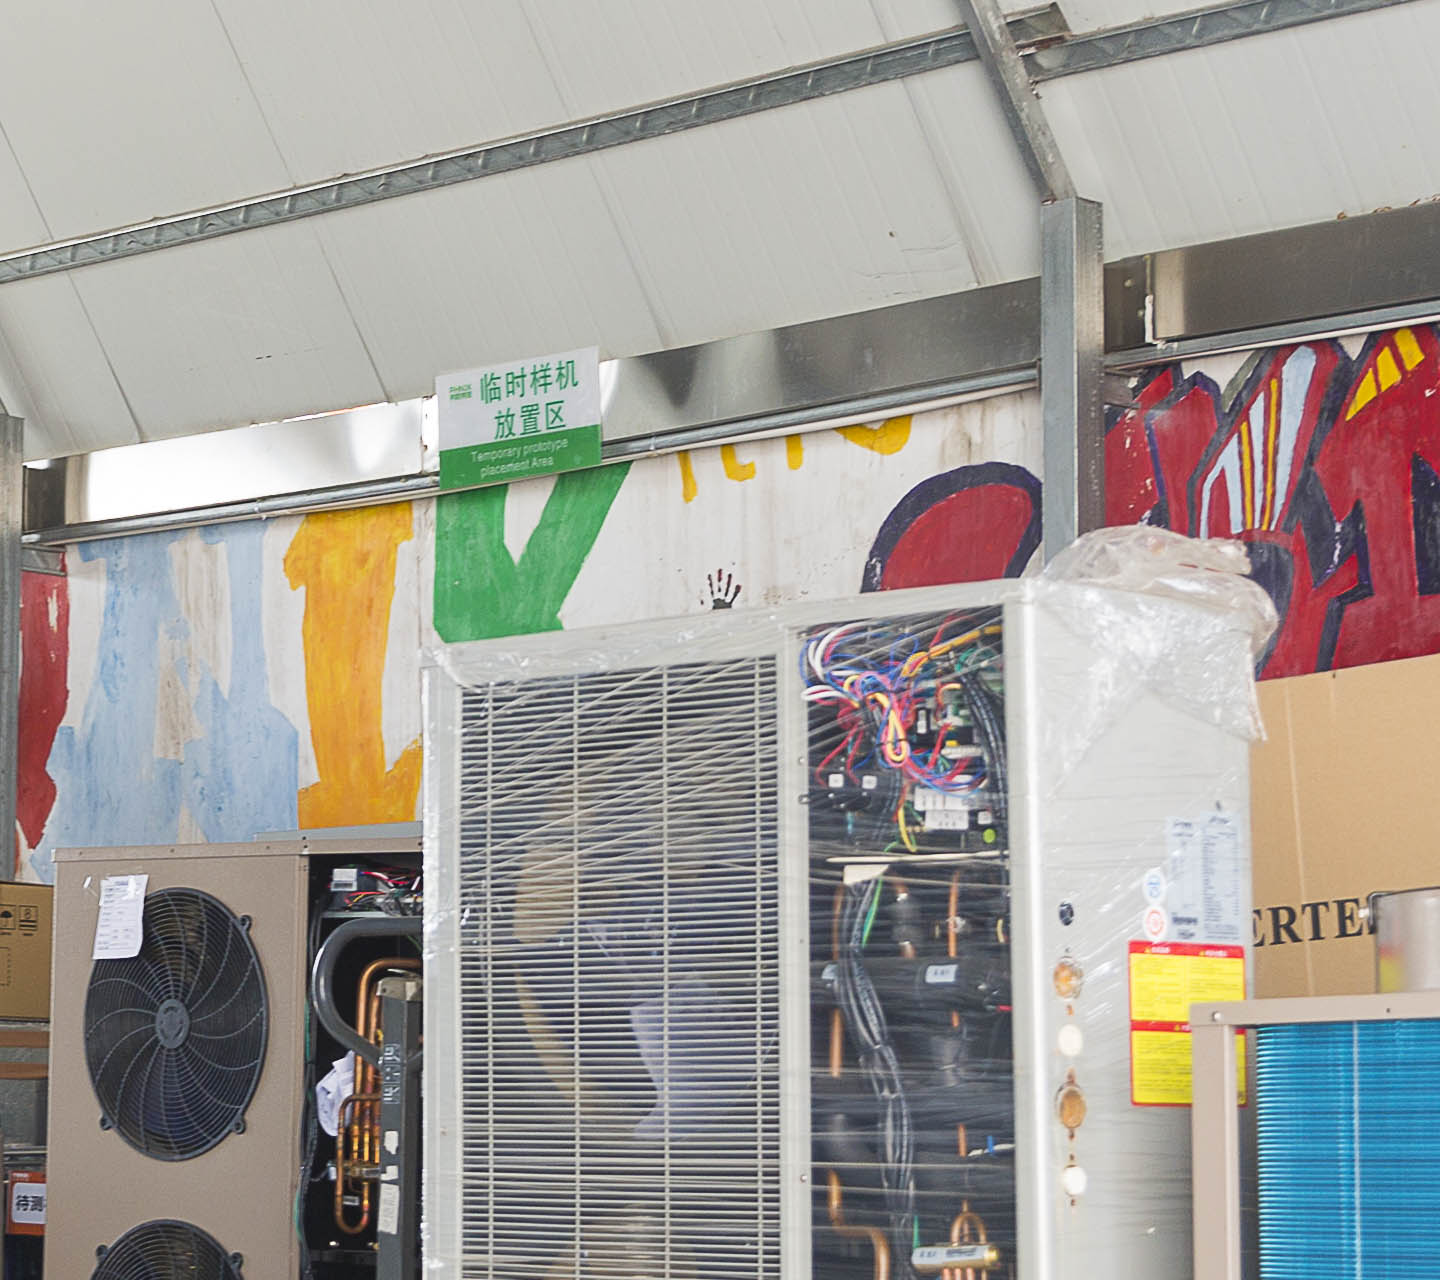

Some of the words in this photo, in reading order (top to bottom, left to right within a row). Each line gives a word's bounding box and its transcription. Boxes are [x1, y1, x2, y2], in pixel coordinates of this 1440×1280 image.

[480, 360, 579, 404] 临时样机
[494, 400, 567, 440] 放置区
[471, 446, 522, 464] Temporary
[523, 437, 569, 456] prototype
[480, 460, 530, 479] placement
[532, 455, 554, 468] Area
